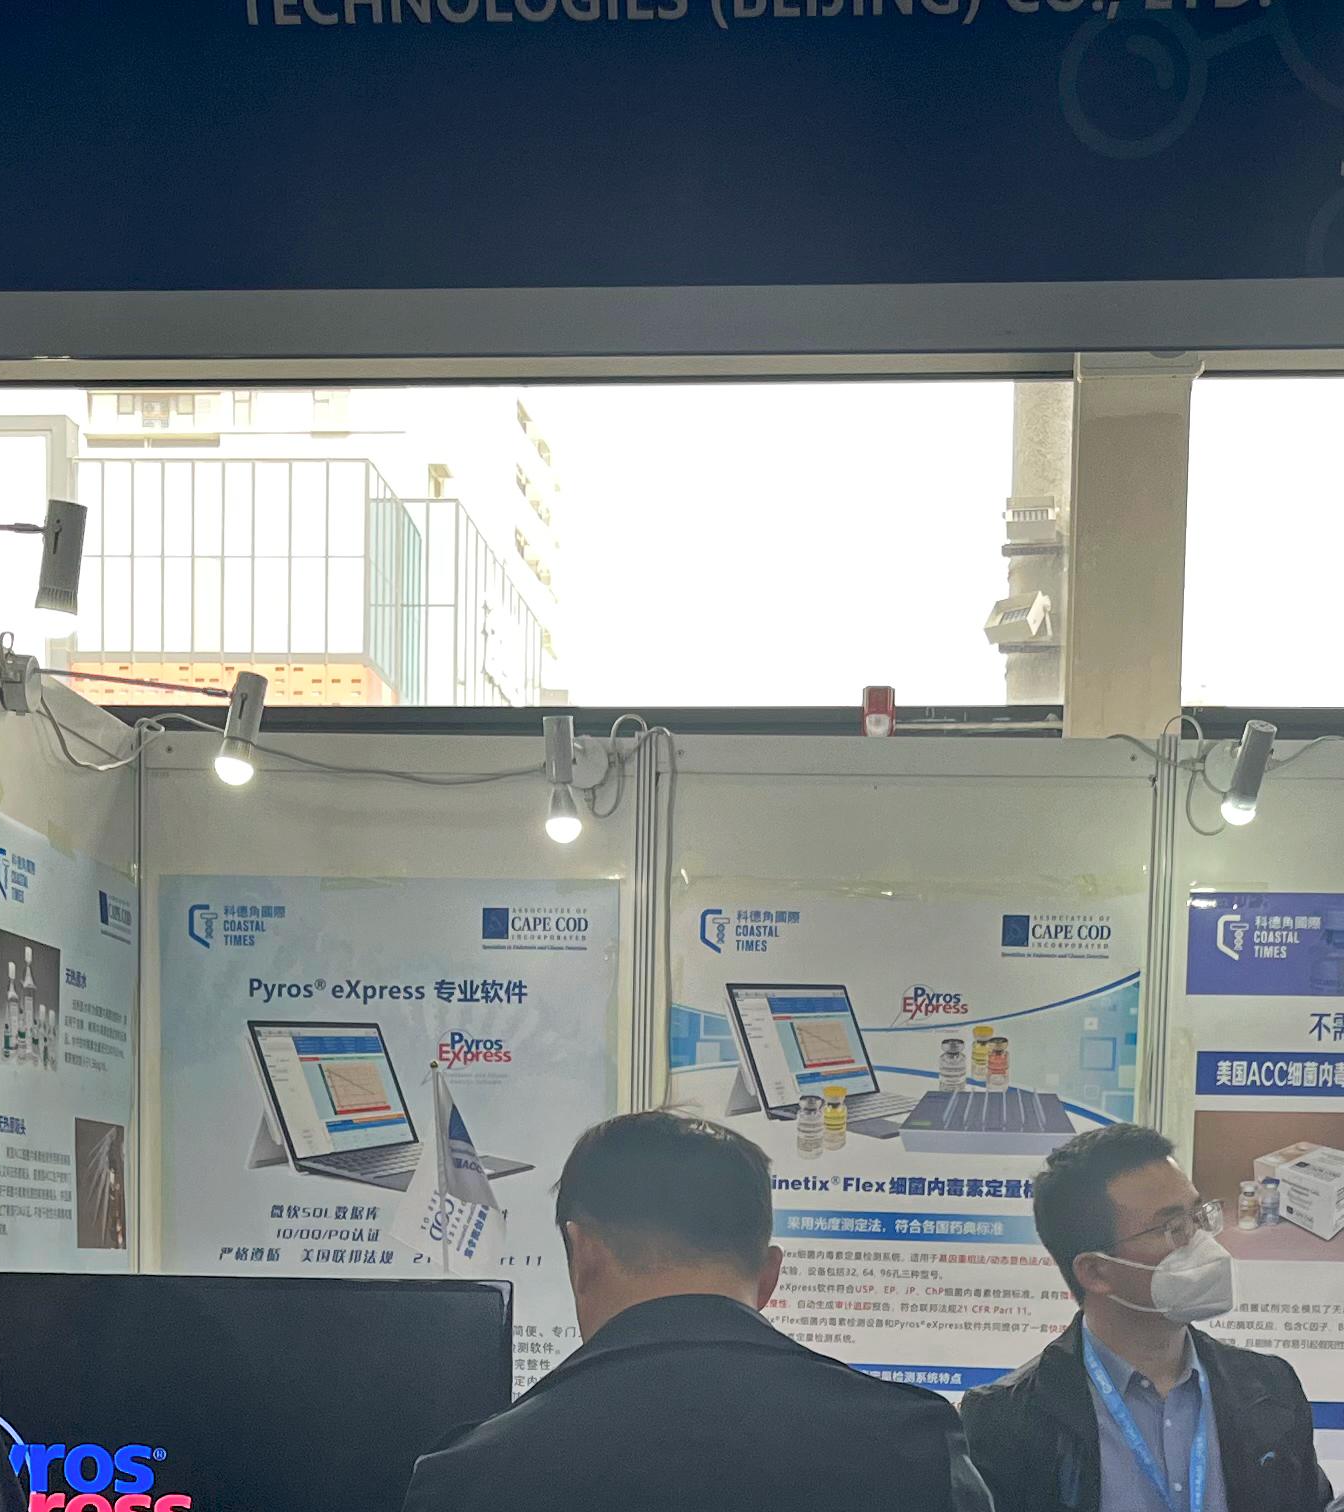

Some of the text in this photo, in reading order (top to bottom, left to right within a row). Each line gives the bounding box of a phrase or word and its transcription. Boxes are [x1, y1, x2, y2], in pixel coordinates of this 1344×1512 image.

[223, 919, 266, 933] COASTAL
[510, 916, 588, 933] CAPE COD
[735, 924, 779, 938] COASTAL
[1031, 924, 1111, 941] CAPE COD
[223, 933, 255, 947] TIMES
[1253, 930, 1300, 944] COASTAL
[735, 939, 767, 953] TIMES
[1254, 945, 1287, 959] TIMES
[248, 977, 528, 1005] Pyros® eXpress 专业软件
[913, 986, 961, 1006] Pyros
[450, 1031, 503, 1052] Pyros
[771, 1174, 840, 1192] inetix®
[843, 1177, 886, 1193] Flex
[219, 1247, 281, 1263] 严格遵循
[301, 1247, 394, 1265] 美国联邦法规
[526, 1255, 543, 1267] 11
[9, 1442, 167, 1494] ros®
